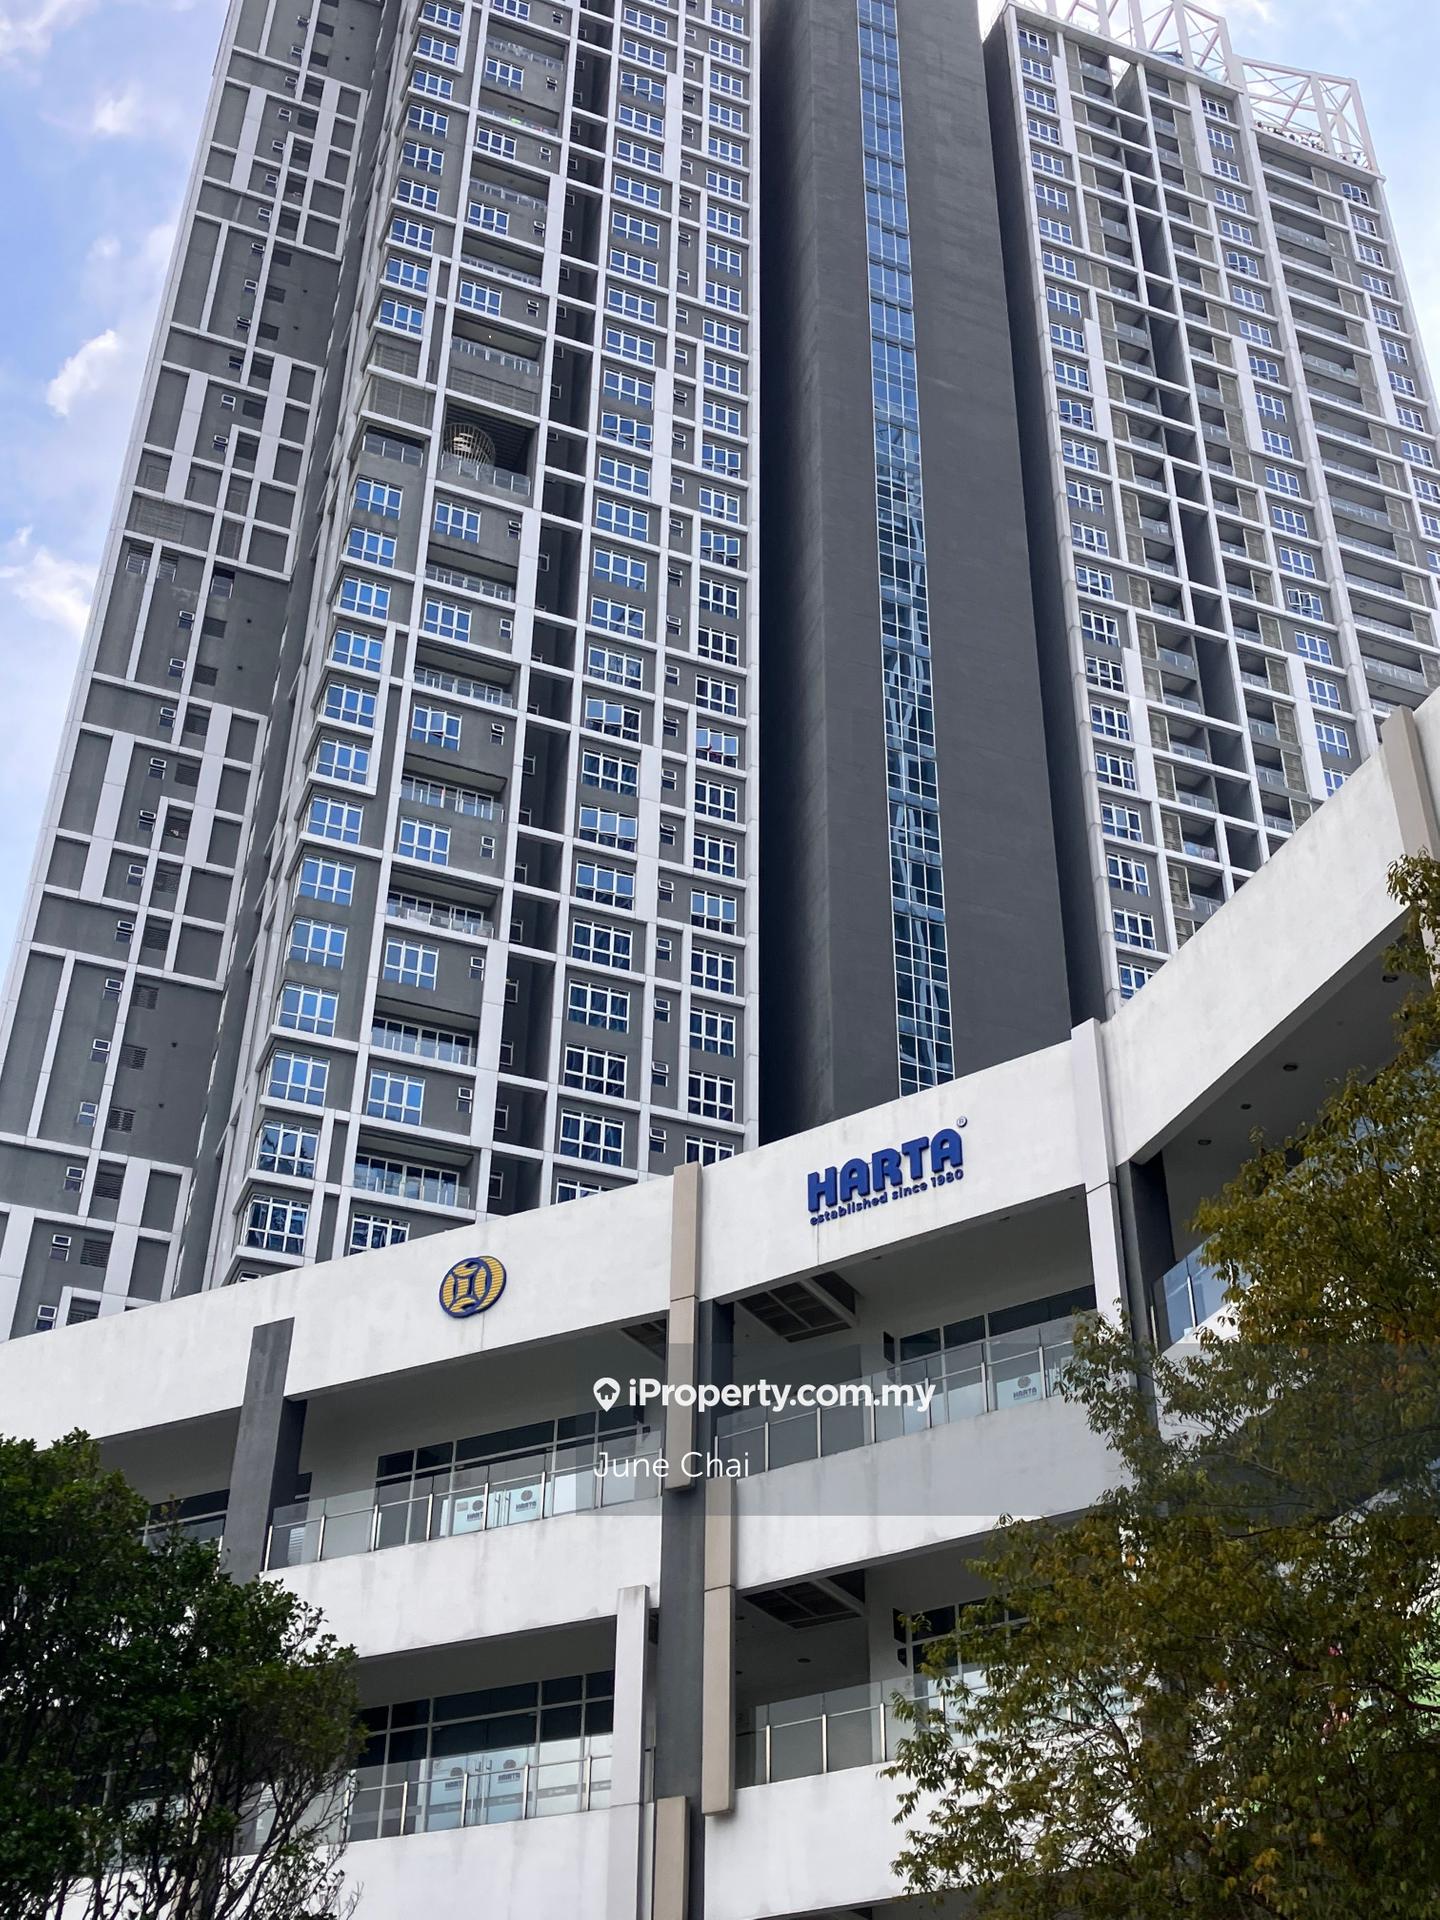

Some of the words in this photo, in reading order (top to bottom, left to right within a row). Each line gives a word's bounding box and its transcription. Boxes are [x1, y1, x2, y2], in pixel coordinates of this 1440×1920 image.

[808, 1128, 963, 1213] HARTA
[810, 1191, 888, 1226] established
[891, 1181, 928, 1201] since
[930, 1168, 964, 1188] 1980
